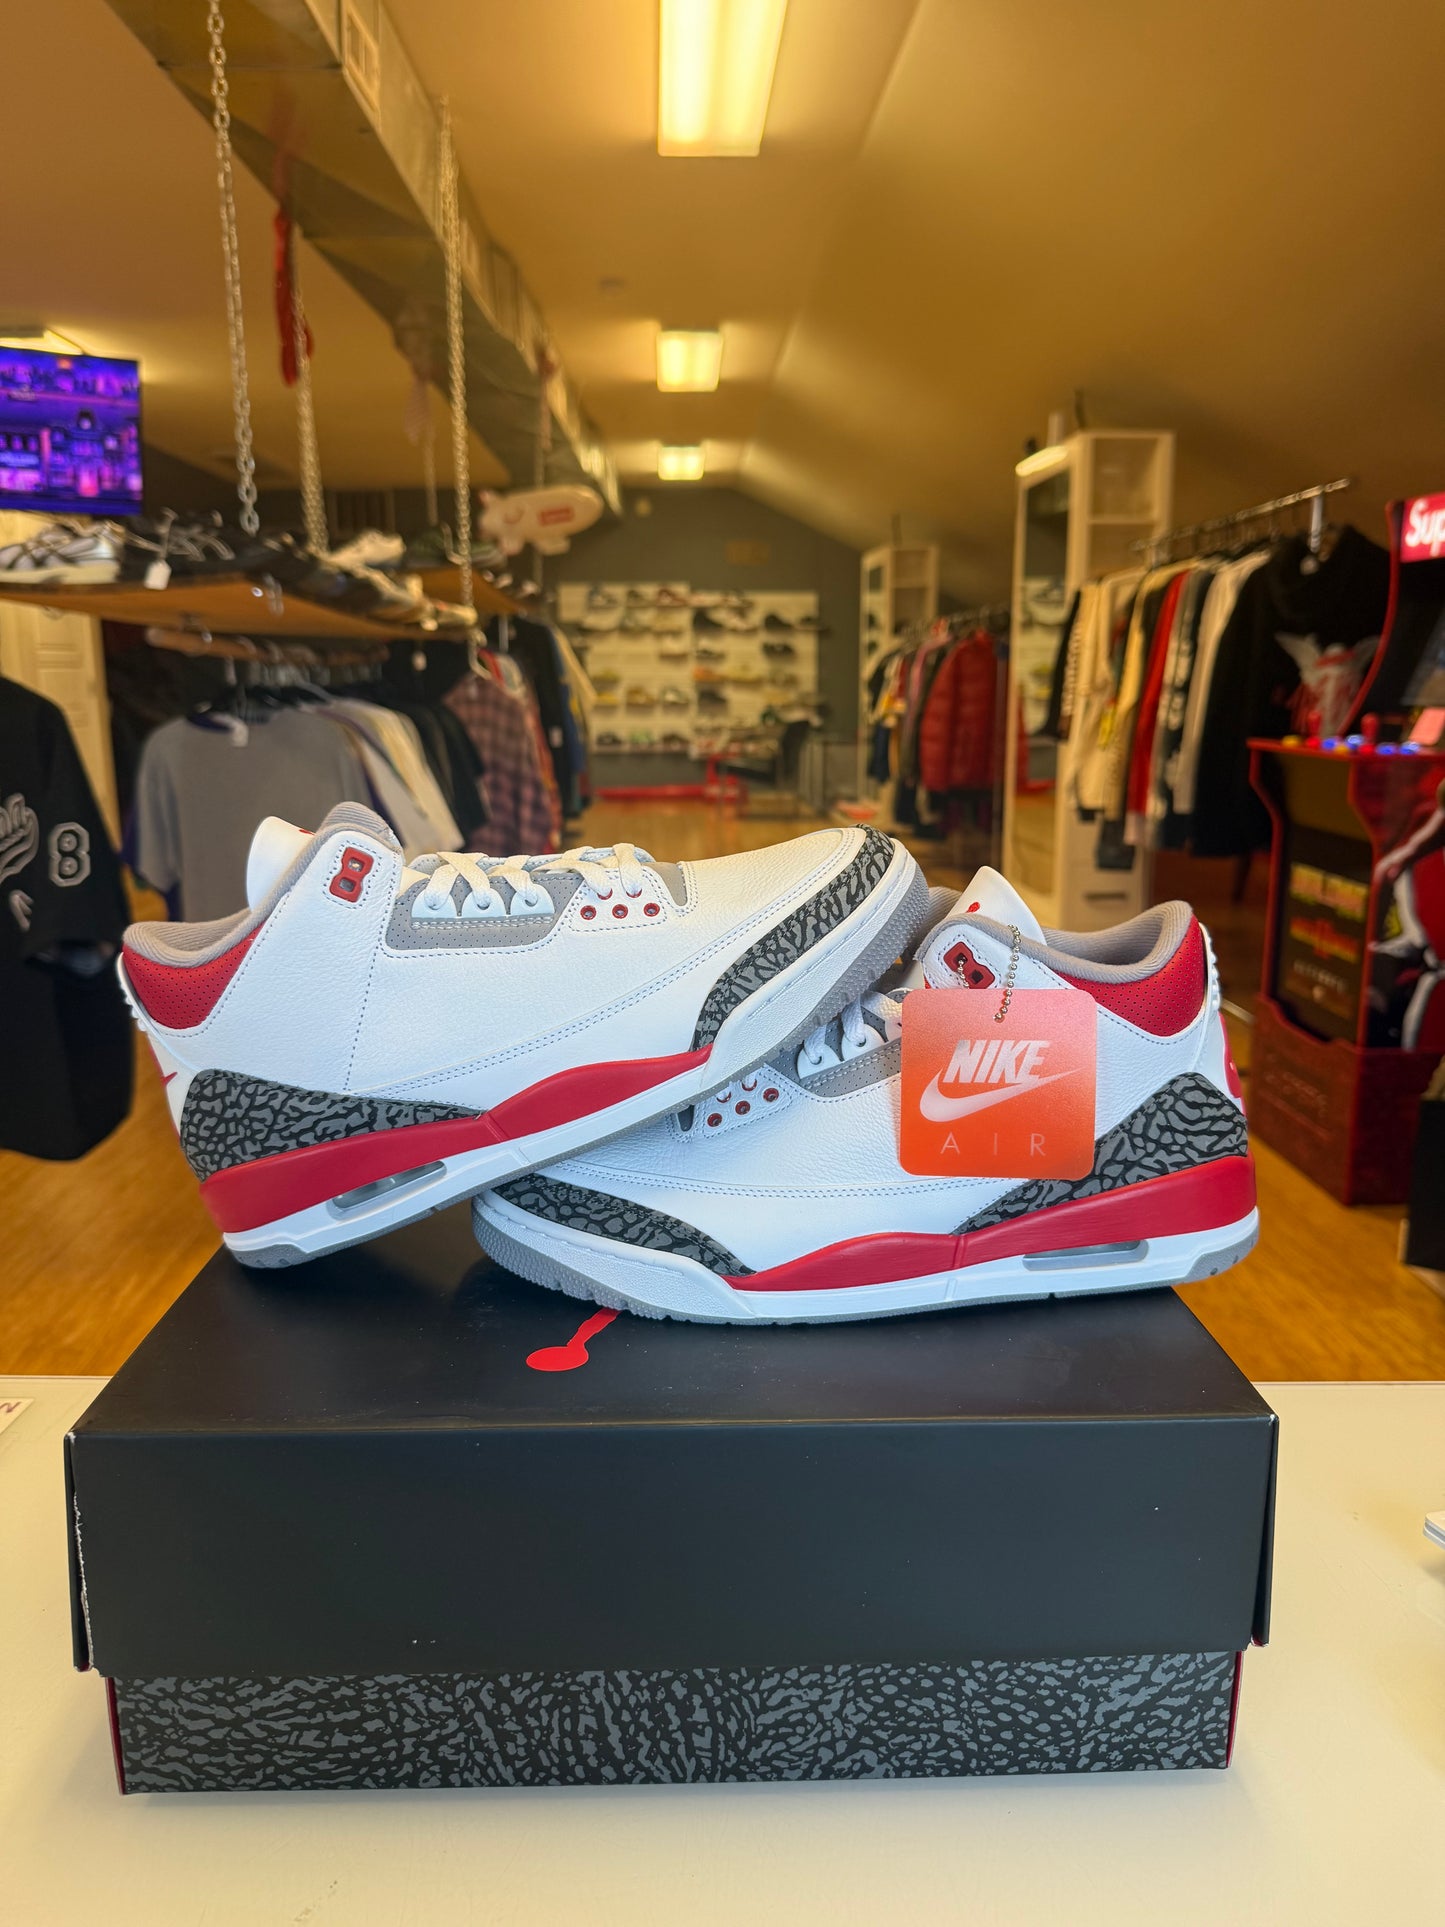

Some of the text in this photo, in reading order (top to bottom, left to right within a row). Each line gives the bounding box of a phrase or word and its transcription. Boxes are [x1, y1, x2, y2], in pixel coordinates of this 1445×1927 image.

[49, 821, 91, 888] 8
[942, 1039, 1051, 1084] NIKE
[940, 1131, 1046, 1157] AIR
